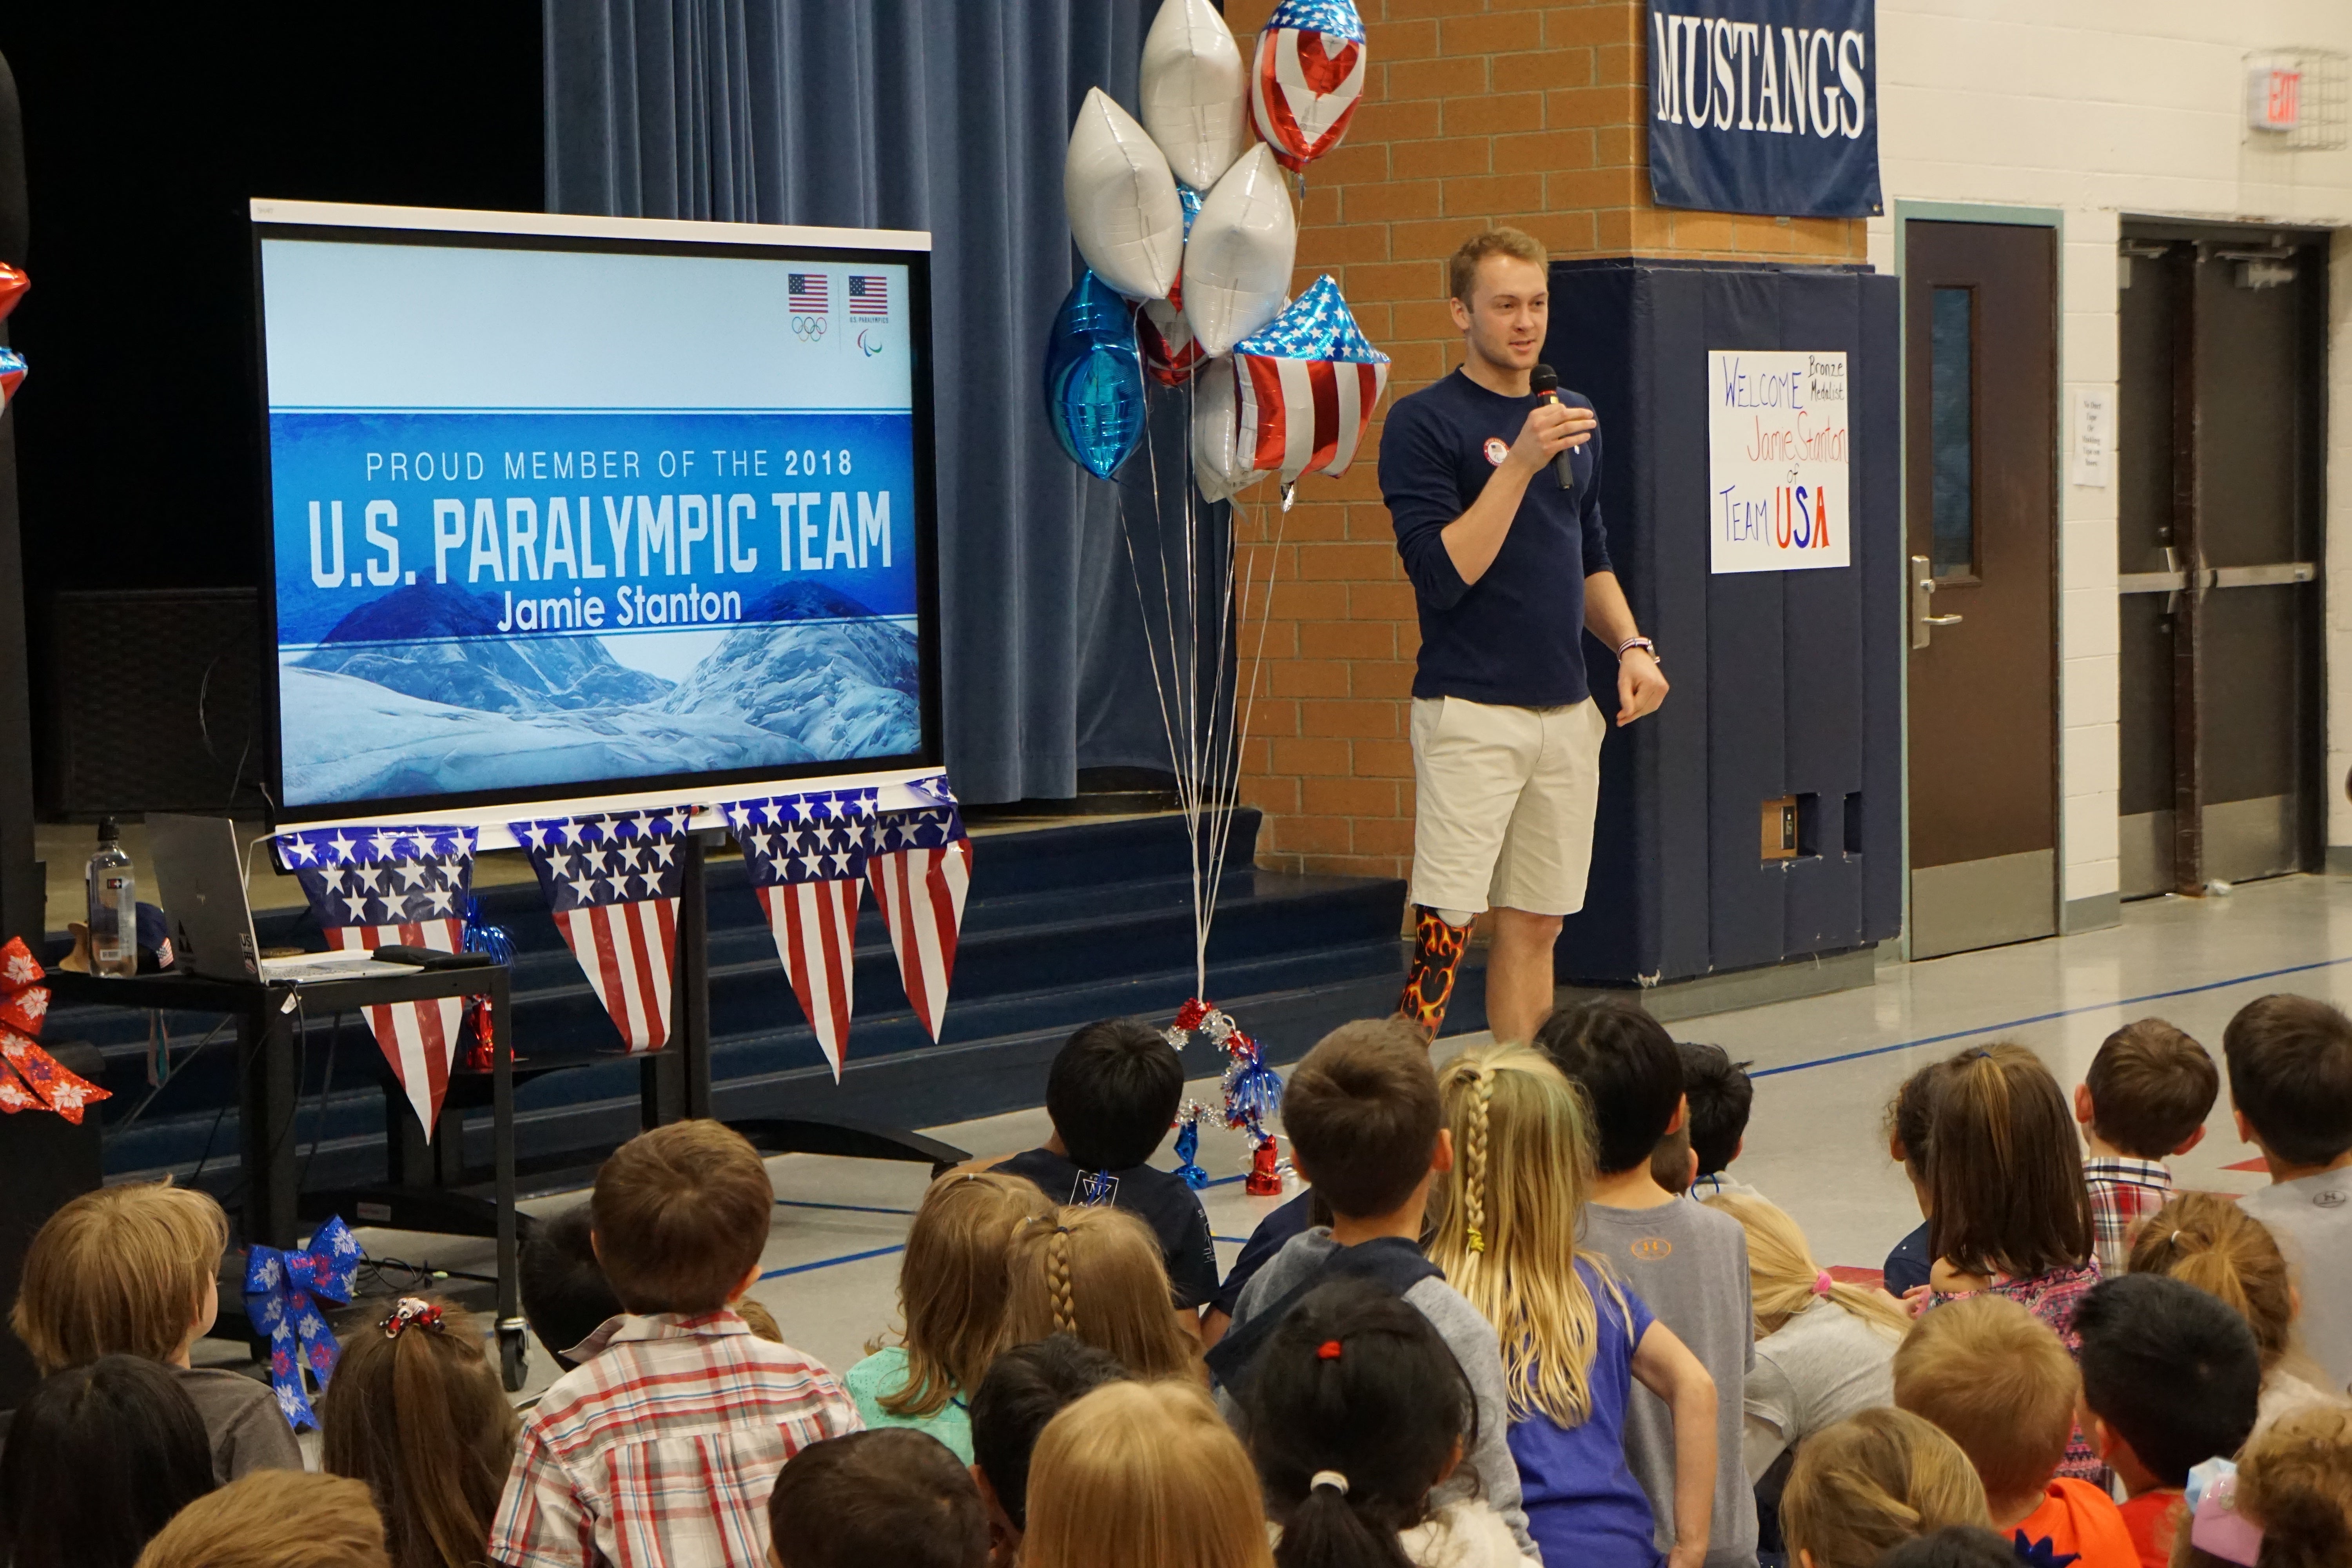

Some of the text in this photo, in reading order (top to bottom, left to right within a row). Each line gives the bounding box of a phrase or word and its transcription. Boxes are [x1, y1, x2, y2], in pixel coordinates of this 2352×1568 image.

[1654, 11, 1865, 140] MUSTANGS
[1723, 356, 1804, 409] WELCOME
[1808, 355, 1844, 377] Bronze
[1811, 379, 1844, 401] Medalist
[1747, 411, 1849, 463] Jamie Stanton
[367, 449, 851, 481] PROUD MEMBER OF THE 2018
[1787, 463, 1799, 485] of
[309, 490, 891, 588] U.S. PARALYMPIC TEAM
[1719, 485, 1830, 549] TEAM USA
[497, 583, 741, 632] Jamie Stanton
